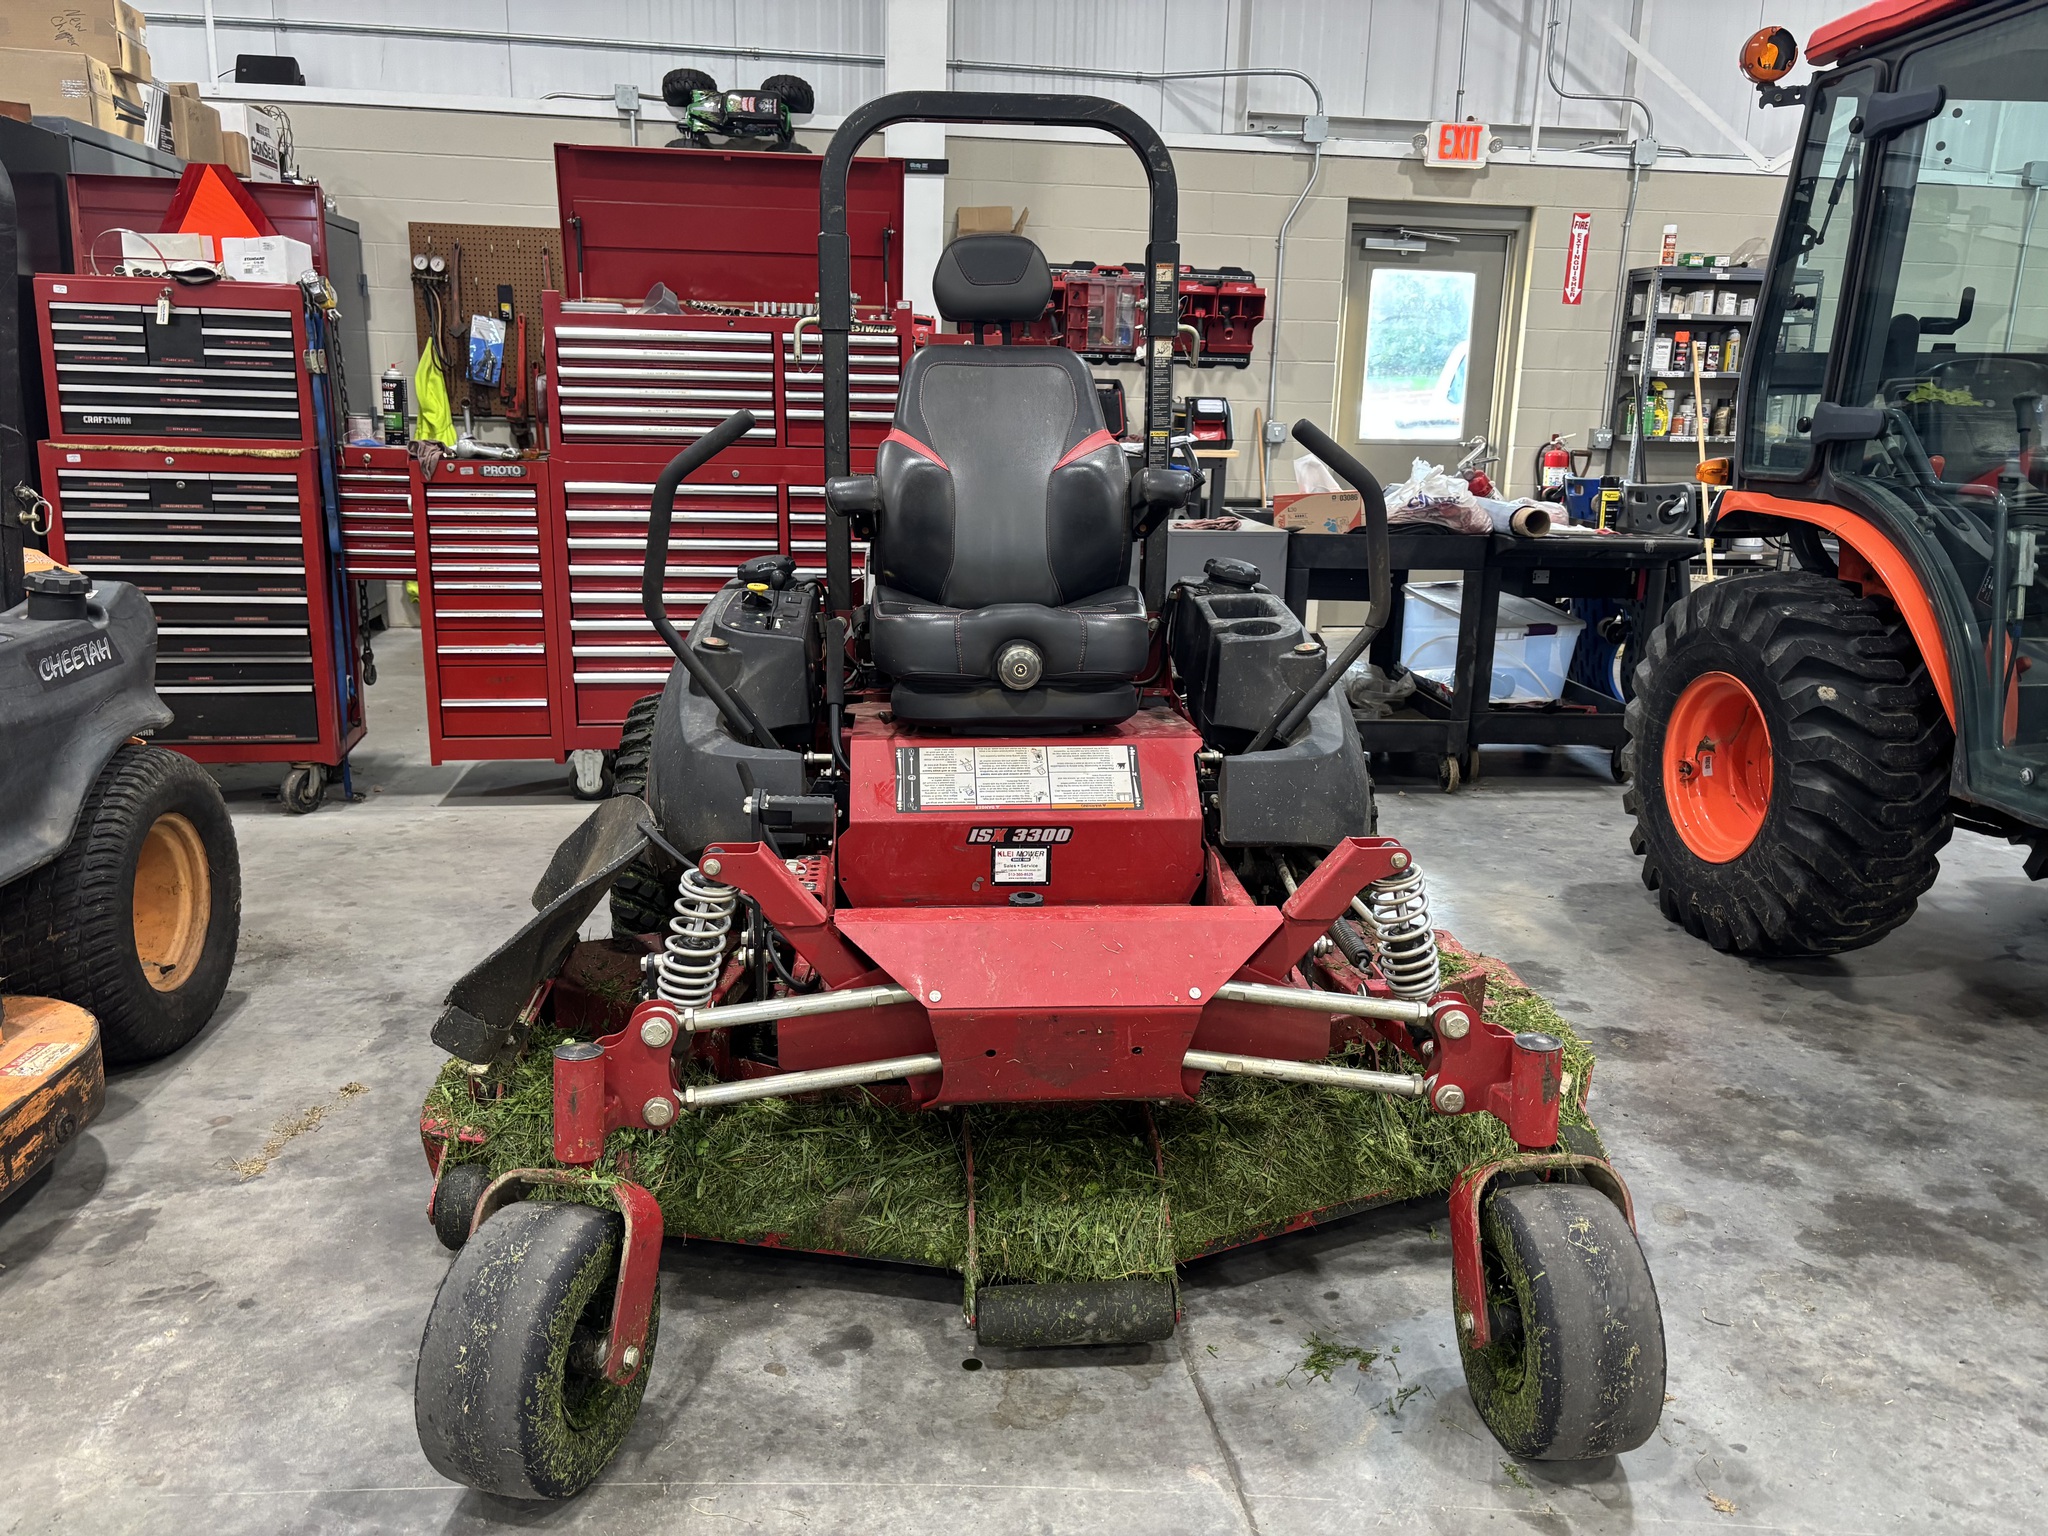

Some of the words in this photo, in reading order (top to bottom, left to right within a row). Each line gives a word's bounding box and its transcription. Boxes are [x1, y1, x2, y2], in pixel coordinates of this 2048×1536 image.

[63, 9, 87, 33] New
[1438, 124, 1484, 161] EXIT
[1573, 220, 1590, 231] FIRE
[1569, 232, 1584, 298] EXTINGUISHER
[850, 324, 897, 334] ESTWARD
[83, 415, 132, 425] CRAFTSMAN
[483, 465, 521, 476] PROTO
[38, 636, 112, 682] CHEETAH
[968, 828, 1008, 842] ISX
[1012, 828, 1073, 842] 3300
